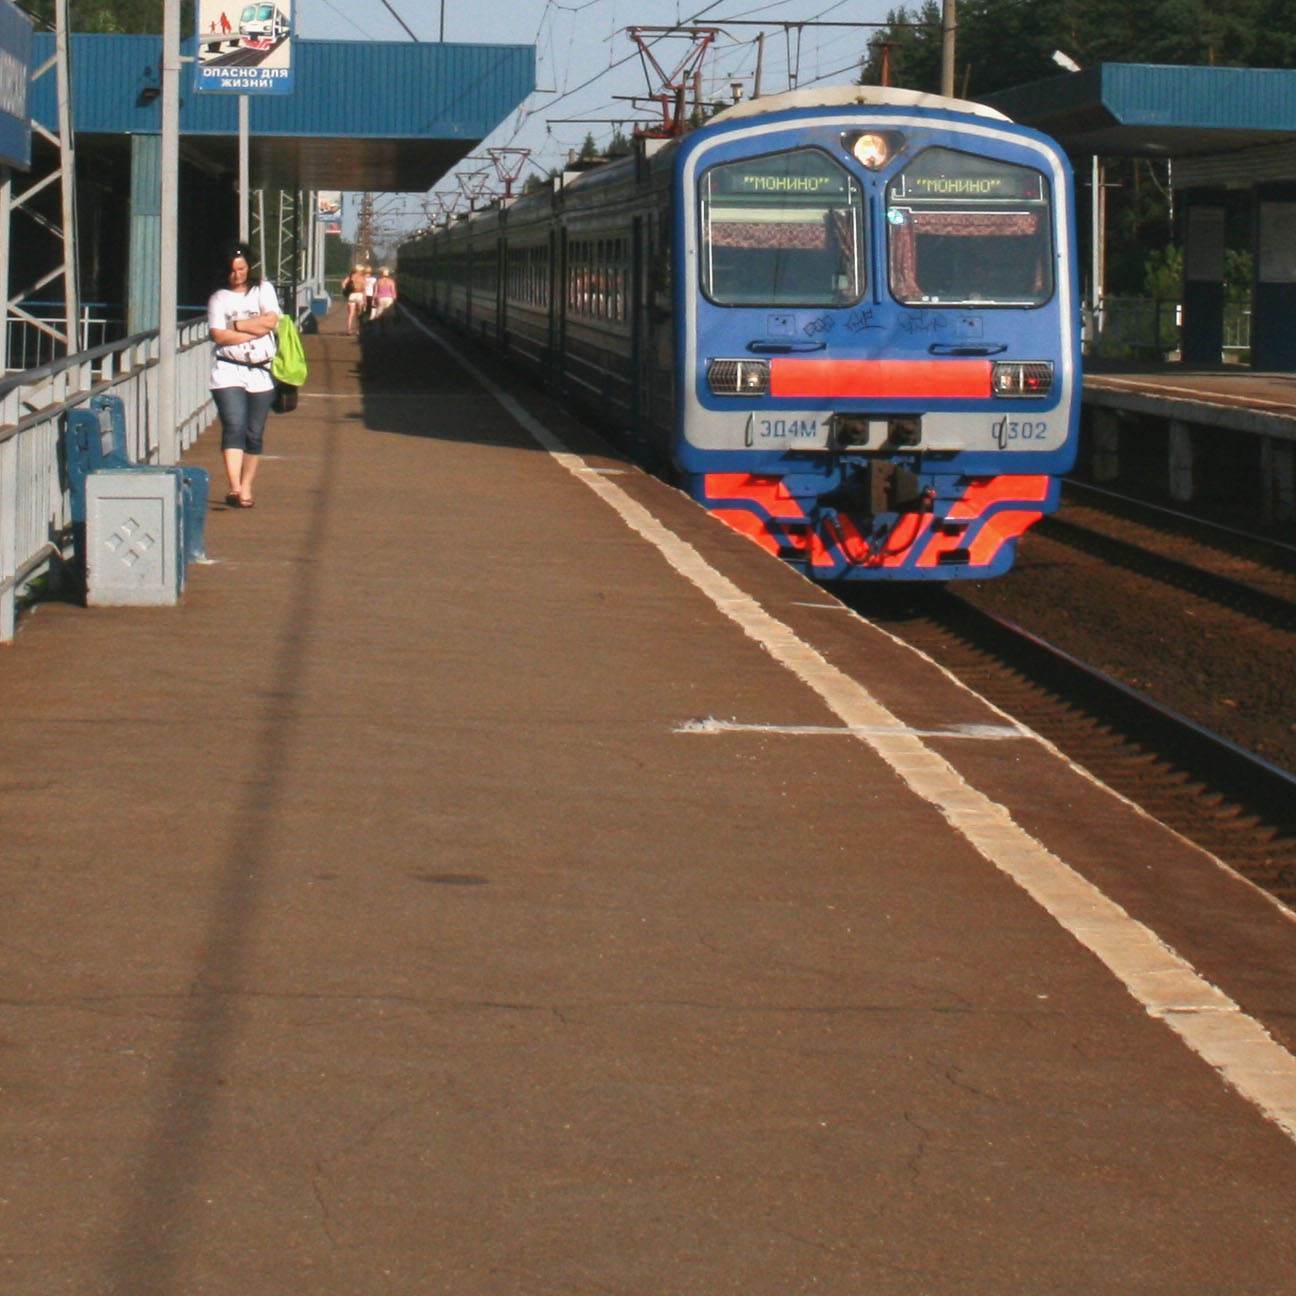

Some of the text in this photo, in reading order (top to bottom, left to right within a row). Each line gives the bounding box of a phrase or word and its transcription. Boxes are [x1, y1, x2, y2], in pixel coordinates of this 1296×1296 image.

[203, 68, 289, 79] ОПАСНО ДЛЯ
[221, 78, 273, 88] ЖИЗНИ!
[760, 420, 817, 438] ЭД4М
